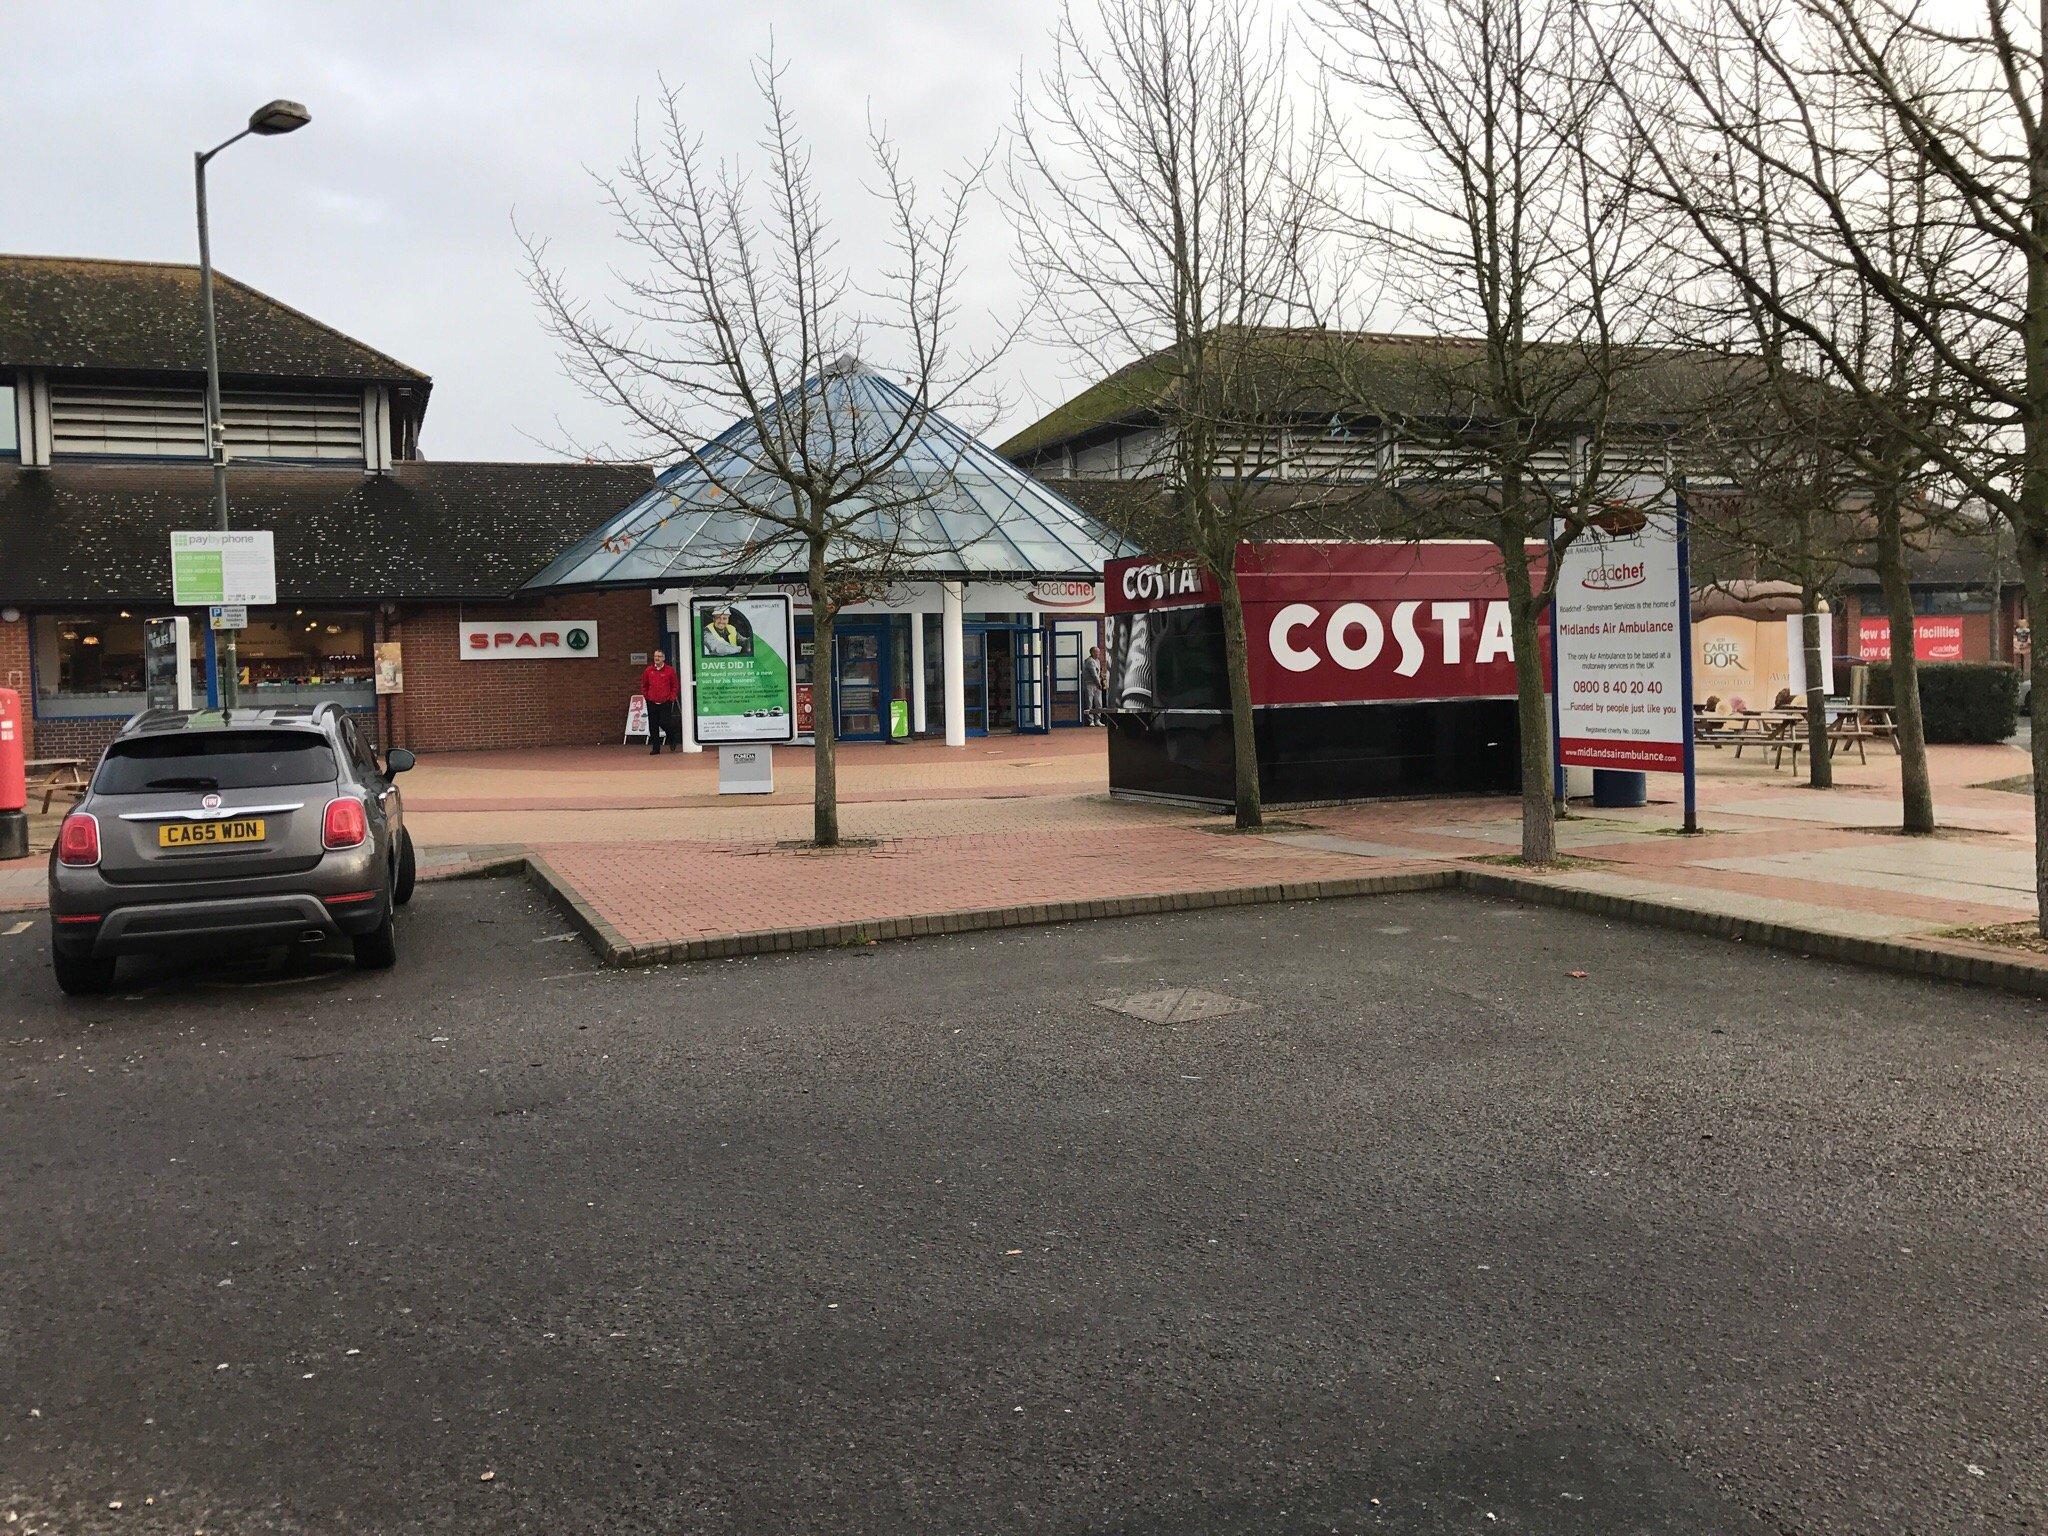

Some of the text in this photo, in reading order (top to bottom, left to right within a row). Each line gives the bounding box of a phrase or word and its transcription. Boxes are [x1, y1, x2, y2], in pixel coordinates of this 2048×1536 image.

[1587, 562, 1644, 582] roadchef
[1122, 561, 1198, 600] COSTA
[1613, 602, 1635, 611] Services
[1653, 601, 1669, 609] home
[1669, 600, 1676, 608] of
[1560, 620, 1674, 636] Midlands Air Ambulance
[1919, 626, 1960, 639] facilities
[469, 632, 560, 650] SPAR
[1268, 600, 1516, 678] COSTA
[1703, 642, 1740, 653] CARTE
[1568, 653, 1578, 661] The
[1578, 653, 1589, 662] only
[1597, 652, 1626, 660] Ambulance
[1633, 652, 1641, 660] be
[1642, 652, 1659, 660] based
[1703, 652, 1749, 671] D'OR
[701, 660, 755, 670] DAVE DID IT
[1581, 663, 1607, 671] motorway
[1636, 662, 1646, 670] the
[1647, 661, 1655, 669] UK
[1573, 681, 1663, 694] 0800 8 40 20 40
[1595, 702, 1604, 714] by
[1606, 704, 1629, 714] people
[1631, 703, 1645, 714] just
[1647, 704, 1661, 713] like
[1663, 706, 1677, 715] you
[1565, 747, 1677, 762] www.midlandsairambulance.com
[168, 821, 258, 843] CA65 WDN
